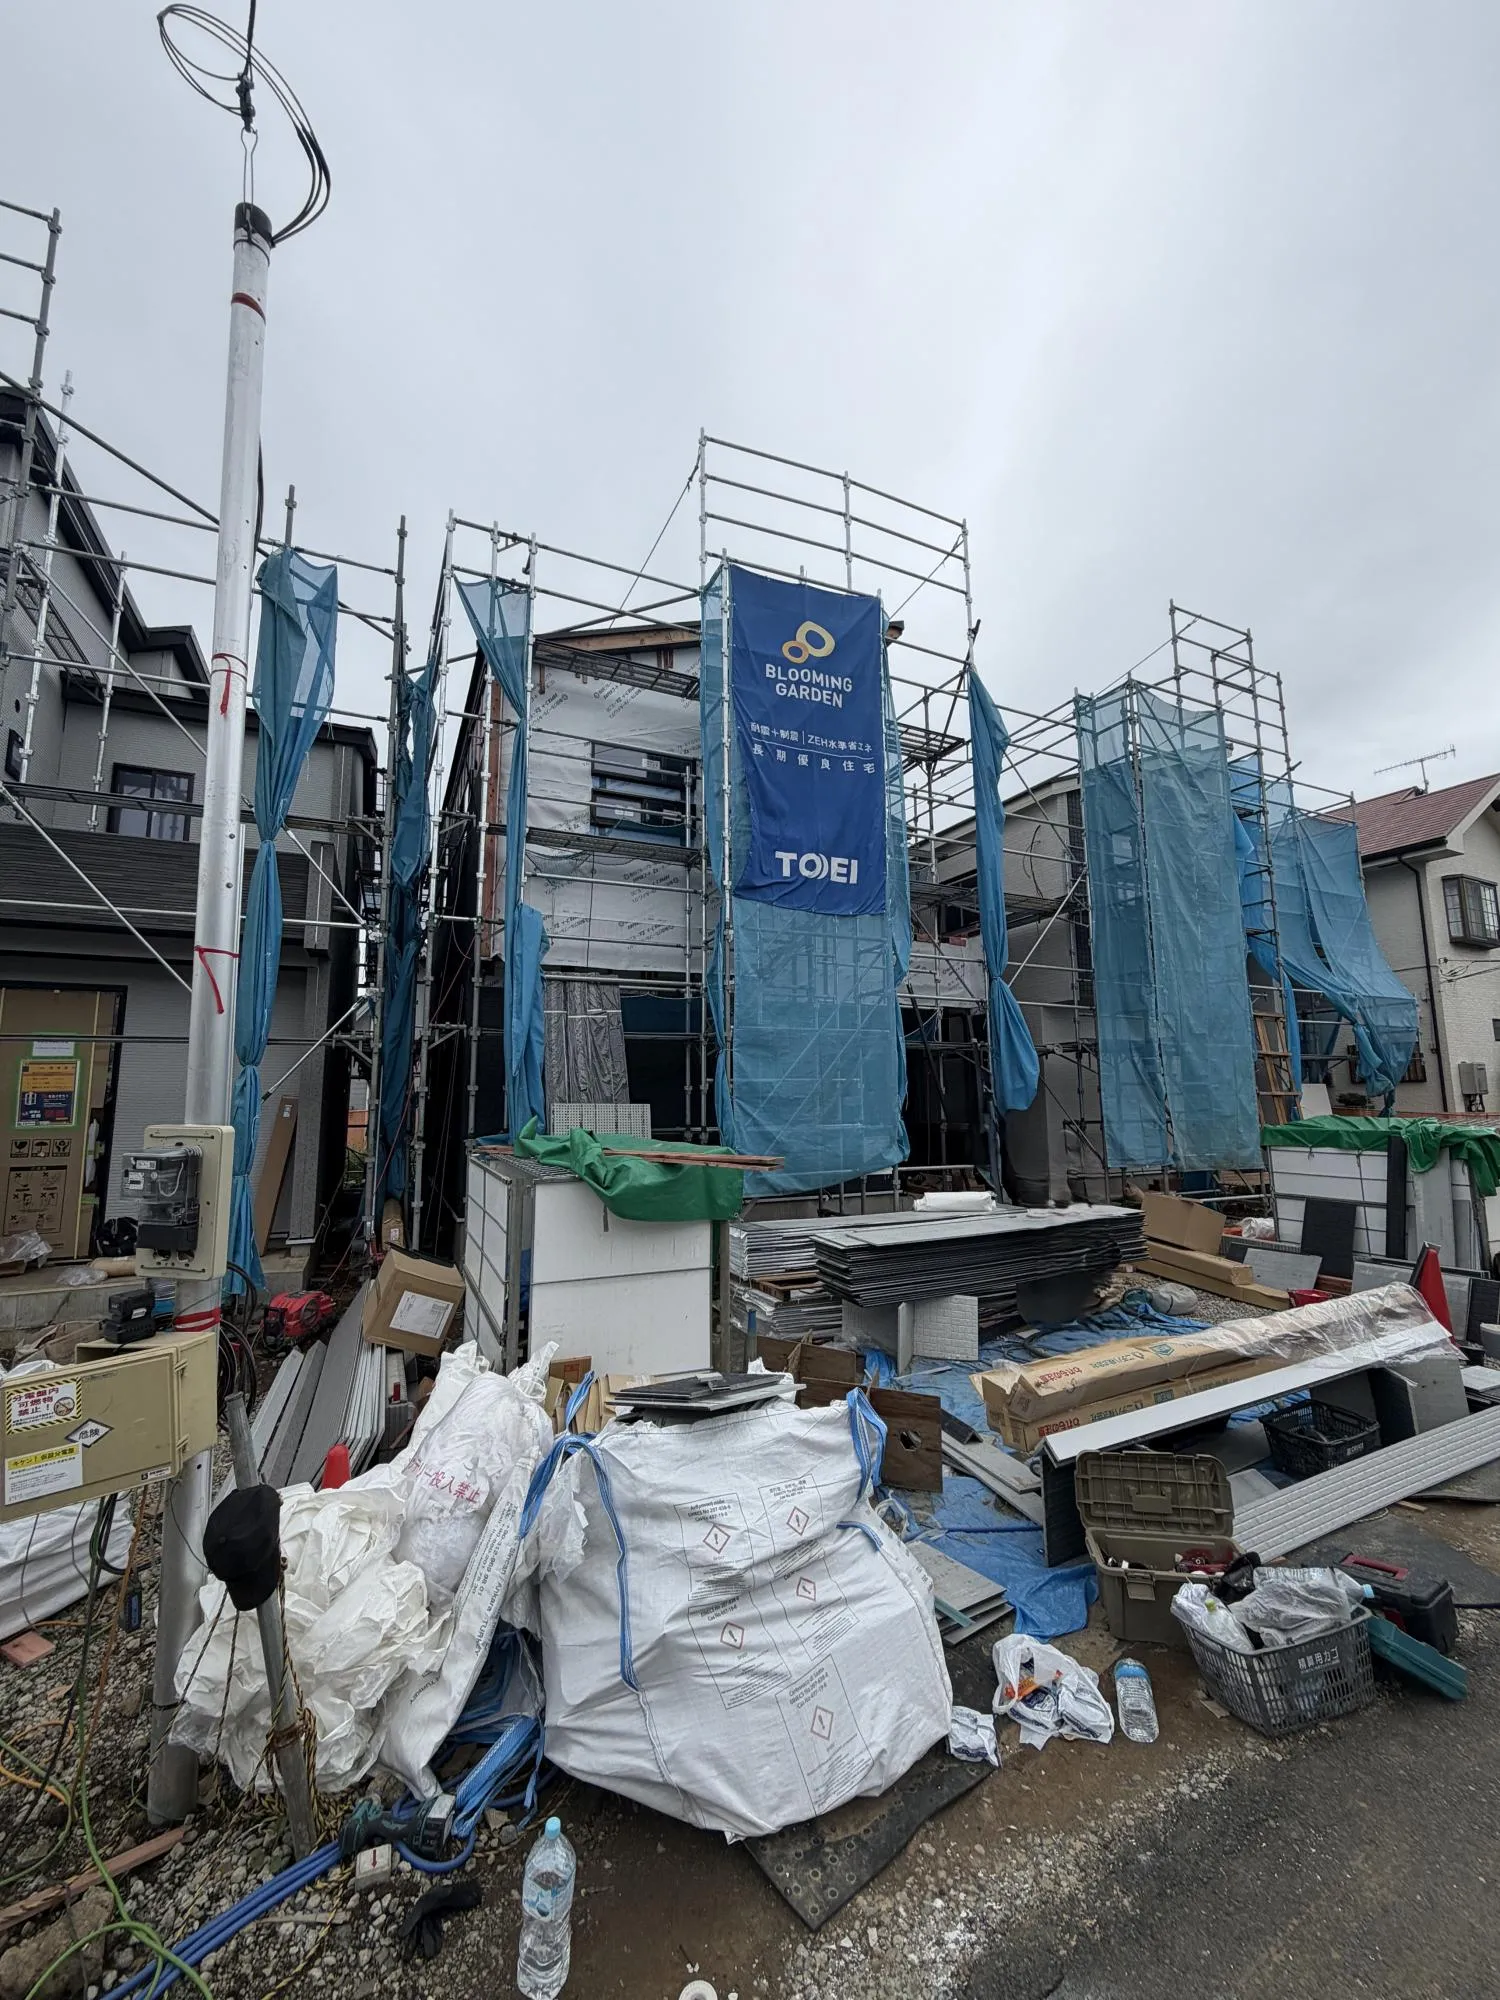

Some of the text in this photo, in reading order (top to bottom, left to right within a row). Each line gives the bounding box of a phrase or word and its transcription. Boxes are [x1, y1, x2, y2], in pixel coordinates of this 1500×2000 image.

[765, 663, 852, 693] BLOOMING
[776, 683, 843, 709] GARDEN
[78, 1427, 100, 1440] 危険
